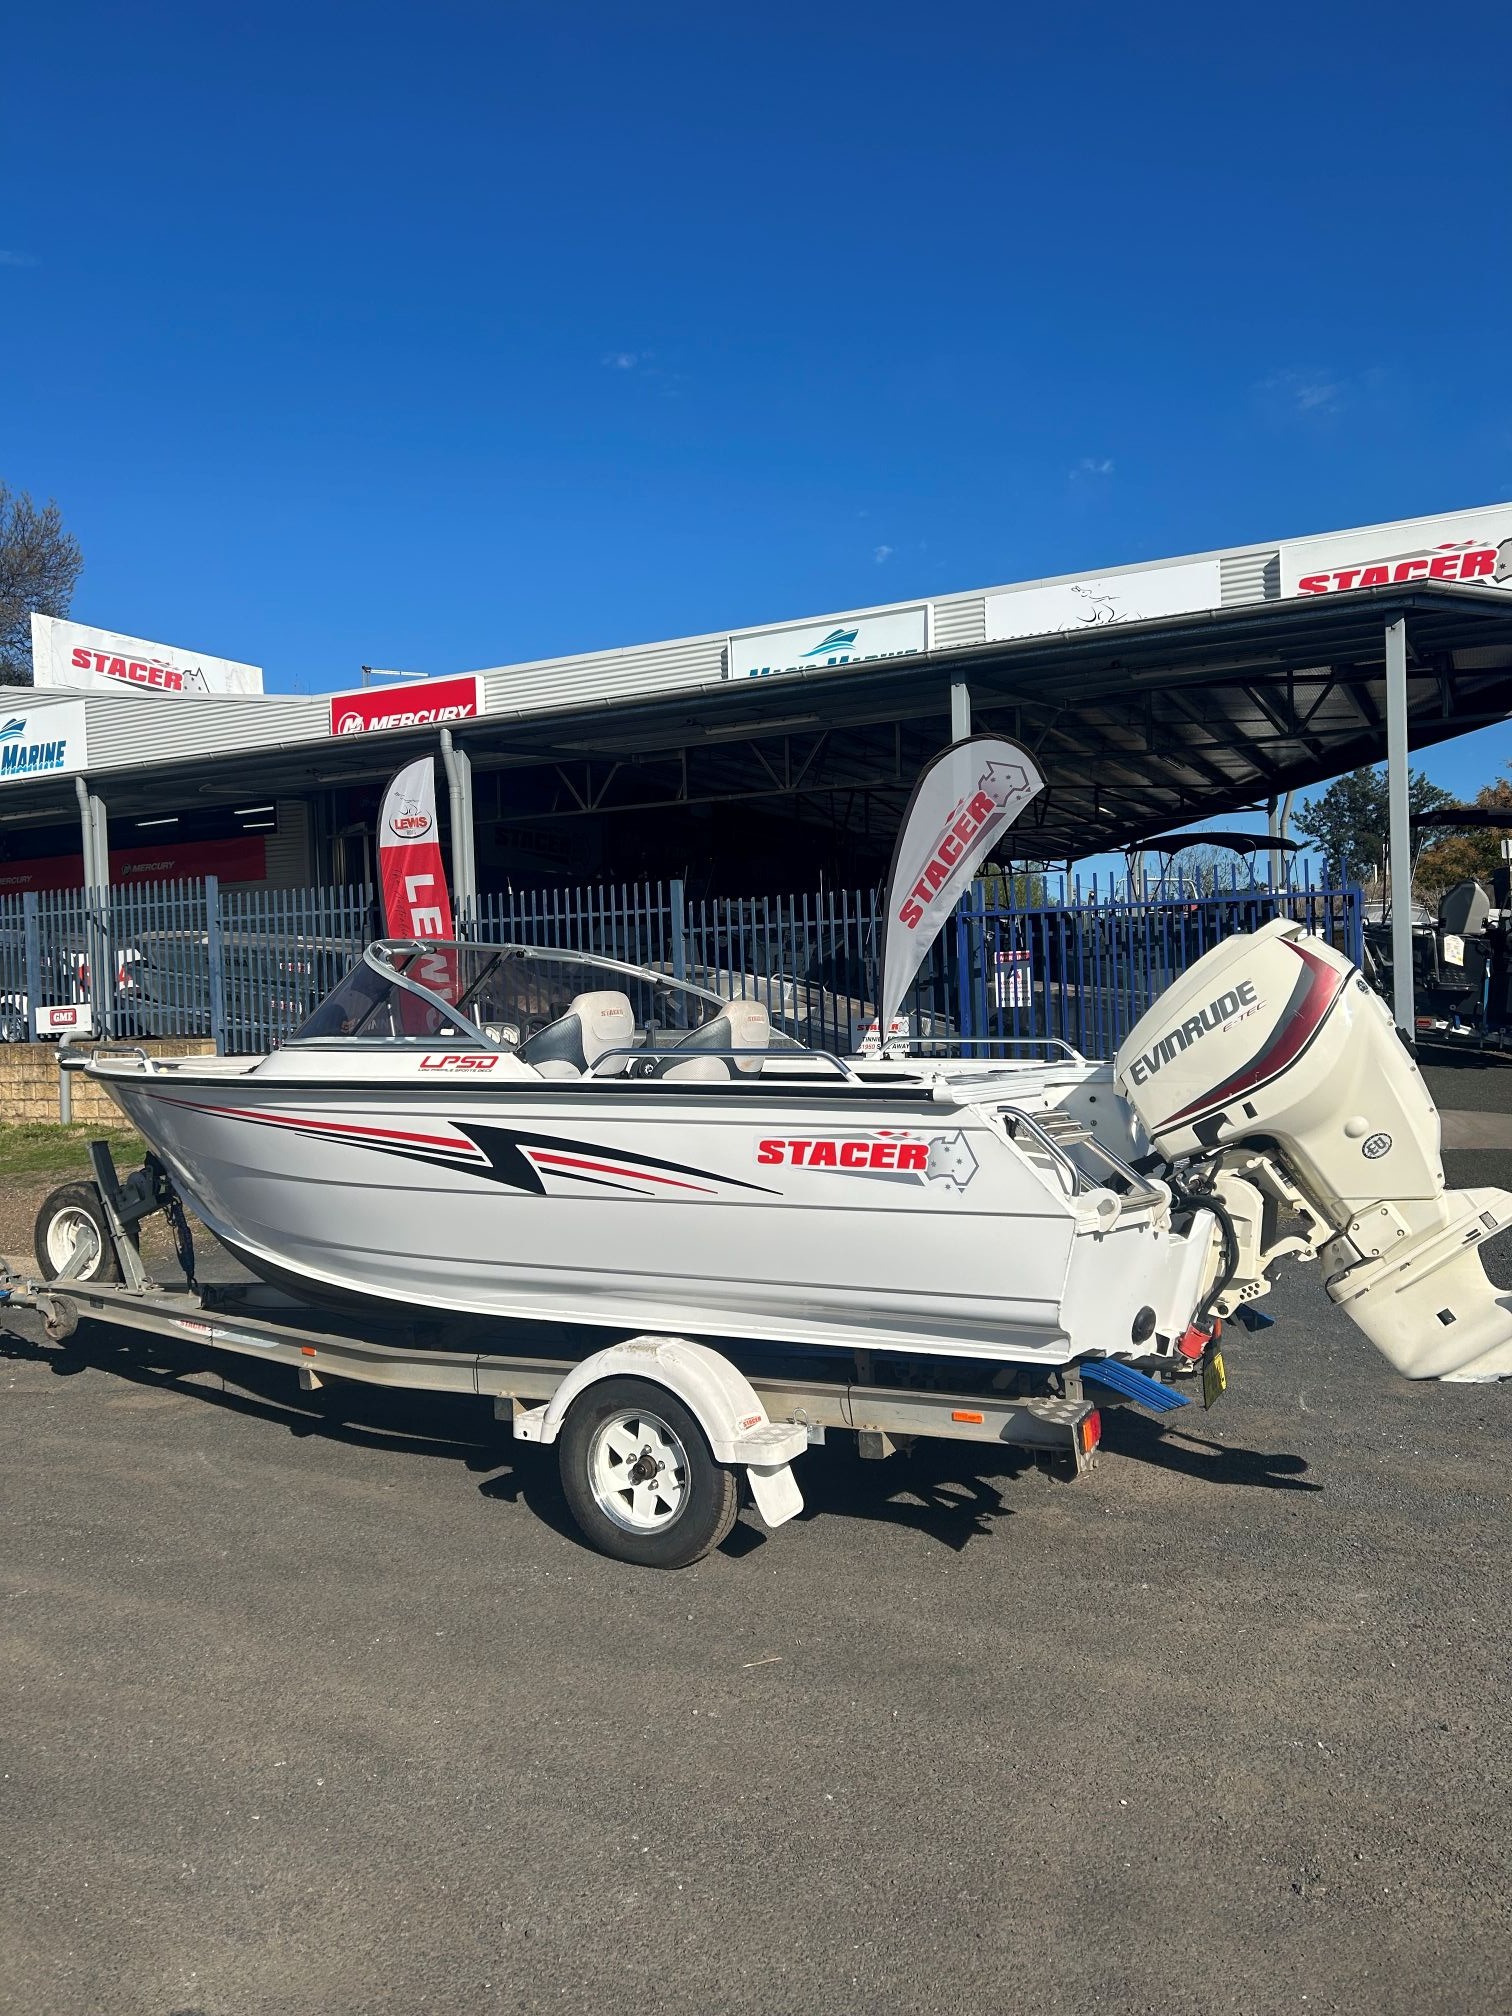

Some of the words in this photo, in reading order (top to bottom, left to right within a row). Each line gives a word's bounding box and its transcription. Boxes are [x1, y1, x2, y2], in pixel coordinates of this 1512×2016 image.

[1297, 549, 1497, 596] STACER
[71, 648, 183, 691] STACER
[369, 703, 473, 731] MERCURY
[0, 740, 66, 775] MARINE
[394, 816, 428, 830] LEWIS
[132, 861, 175, 872] MERCURY
[899, 791, 996, 929] STACER
[0, 875, 32, 885] ERCURY
[53, 1012, 73, 1022] GME
[1223, 1000, 1267, 1033] E-TEC
[1129, 980, 1258, 1086] EVINRUDE
[420, 1056, 499, 1068] LPSD
[757, 1139, 929, 1170] STACER
